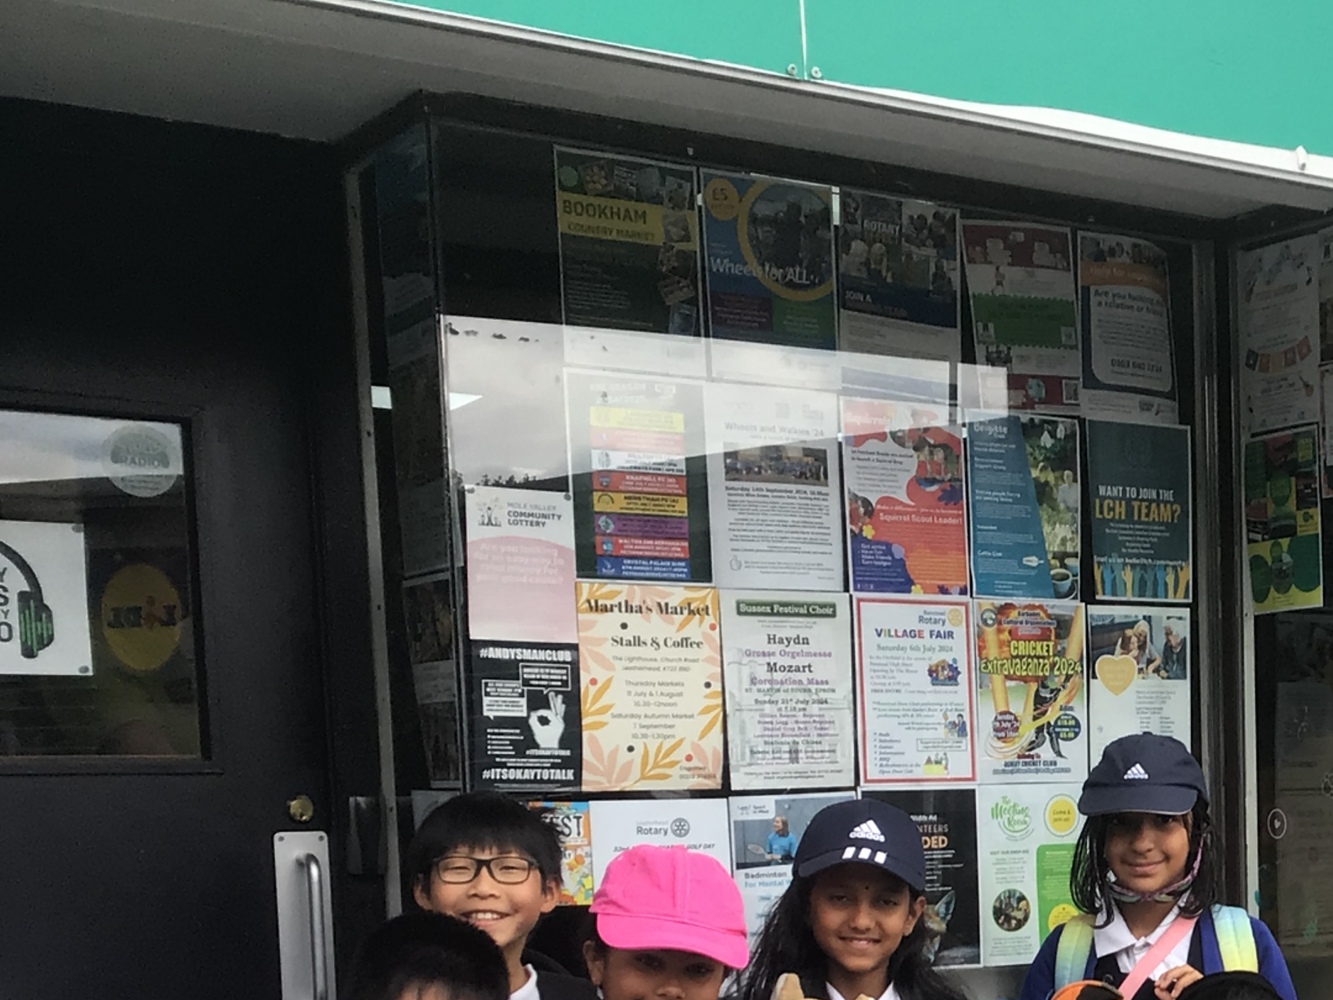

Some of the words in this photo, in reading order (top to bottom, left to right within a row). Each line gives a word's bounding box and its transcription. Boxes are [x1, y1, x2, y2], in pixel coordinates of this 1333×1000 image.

[712, 188, 728, 201] £5
[563, 200, 647, 224] BOOKHAM
[568, 222, 614, 236] COUNTRY
[616, 229, 655, 241] MARKET
[1094, 289, 1109, 297] Are
[759, 425, 776, 433] and
[121, 456, 162, 469] RADIO
[1098, 484, 1123, 497] WANT
[1125, 487, 1137, 498] TO
[1139, 488, 1157, 500] JOIN
[1159, 489, 1174, 502] THE
[507, 502, 527, 510] MOLE
[529, 503, 557, 511] VALLEY
[1094, 498, 1126, 520] LCH
[1131, 501, 1181, 523] TEAM?
[507, 510, 562, 521] COMMUNITY
[879, 512, 910, 523] Squirrel
[911, 515, 933, 523] Scout
[934, 515, 962, 525] Leader!
[508, 519, 546, 528] LOTTERY
[585, 599, 653, 614] Martha's
[655, 601, 711, 617] Market
[740, 603, 772, 613] Sussex
[773, 604, 808, 614] Festival
[809, 605, 834, 615] Choir
[918, 615, 947, 627] Rotary
[874, 627, 925, 639] VILLAGE
[929, 629, 955, 640] FAIR
[611, 635, 648, 648] Stalls
[649, 636, 661, 651] &
[663, 636, 704, 649] Coffee
[766, 633, 810, 648] Haydn
[779, 649, 833, 659] Orgelmesse
[876, 643, 908, 653] Saturday
[922, 644, 936, 653] July
[1010, 640, 1055, 656] CRICKET
[480, 647, 572, 662] #ANDYSMANCLUB
[766, 662, 814, 673] Mozart
[1053, 656, 1082, 675] 2024
[624, 680, 656, 688] Thursday
[750, 676, 804, 687] Coronation
[806, 677, 830, 685] Mass
[659, 691, 684, 699] August
[754, 698, 779, 706] Sunday
[795, 698, 810, 706] July
[482, 768, 575, 780] #ITSOKAYTOTALK
[990, 802, 1030, 820] Meeting
[636, 826, 669, 837] Rotary
[849, 831, 886, 843] adidas
[744, 871, 788, 879] Badminton
[744, 881, 756, 889] for
